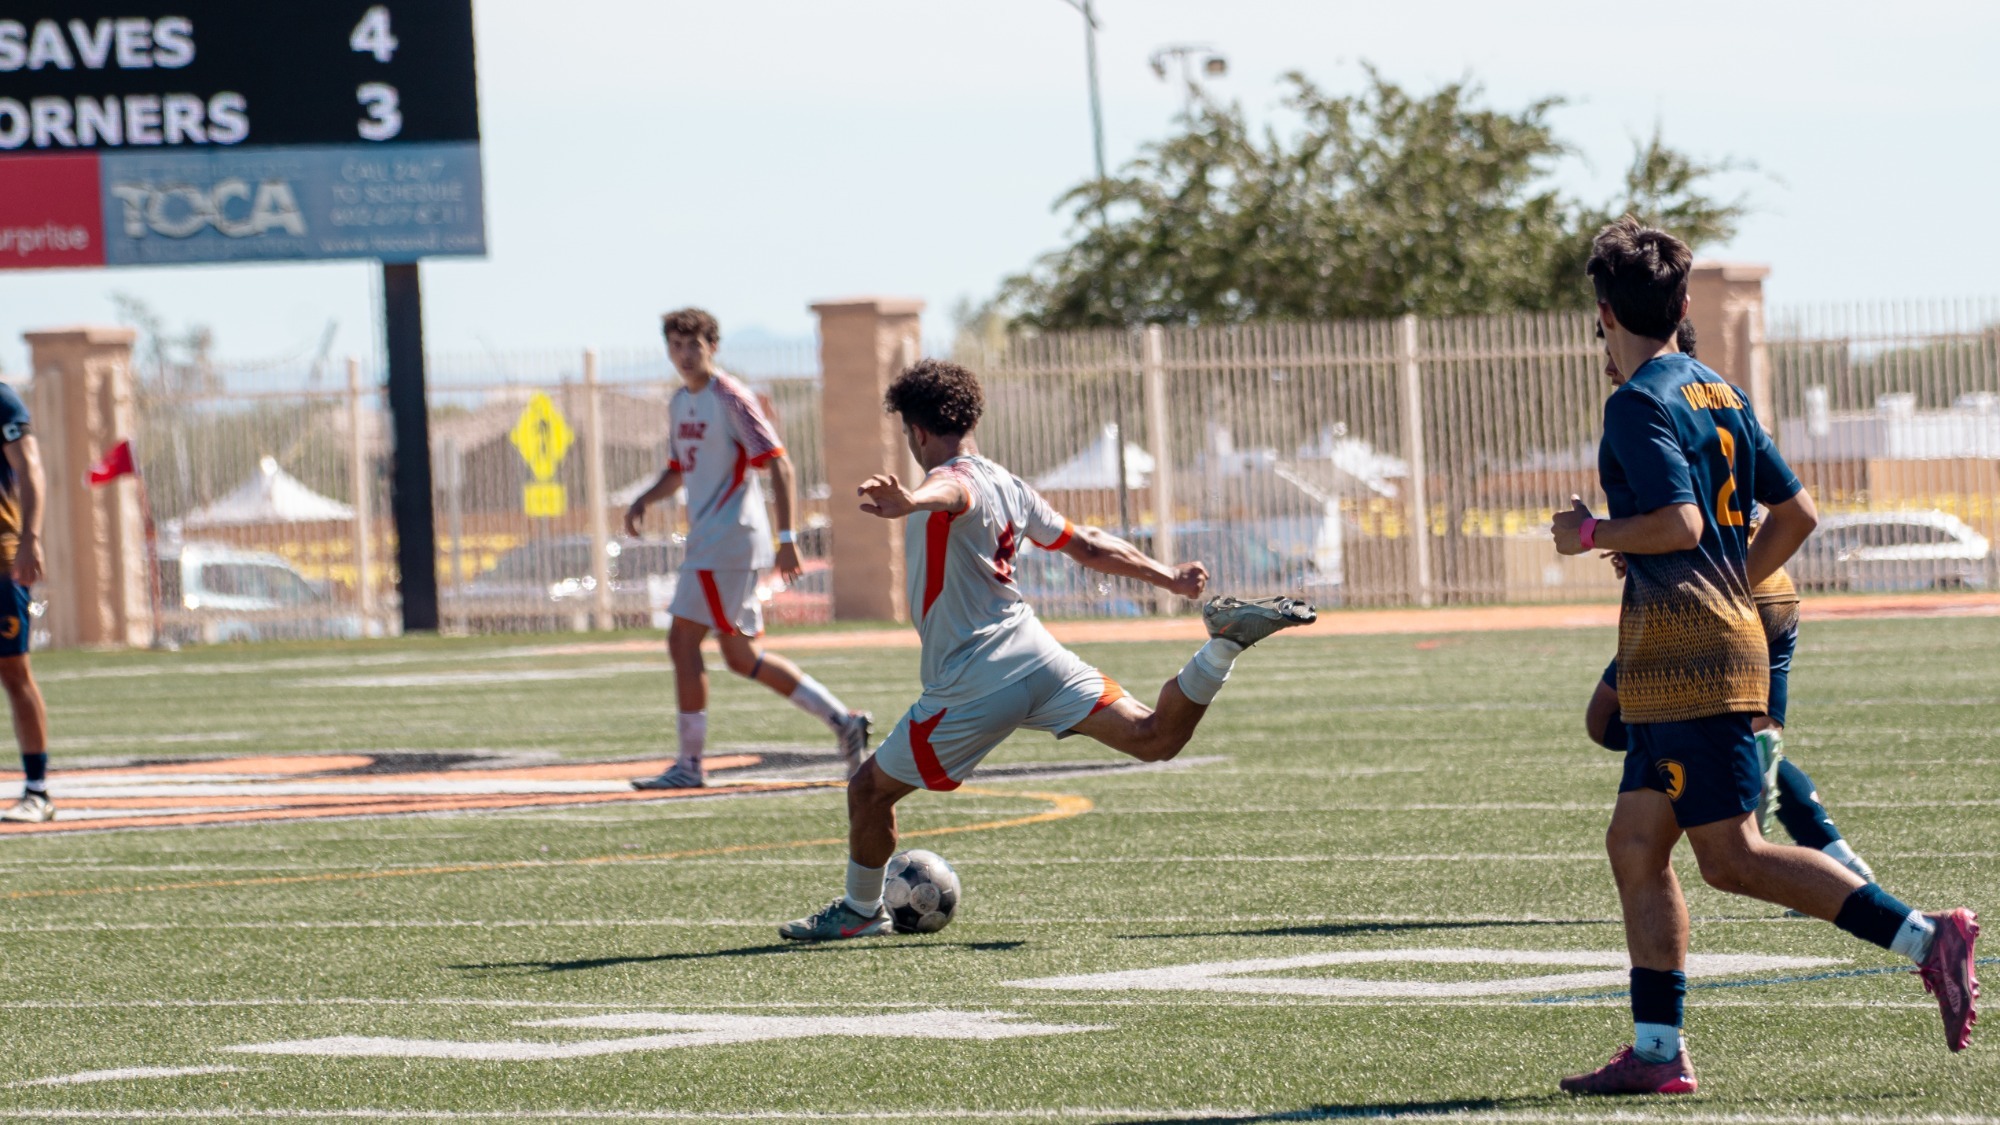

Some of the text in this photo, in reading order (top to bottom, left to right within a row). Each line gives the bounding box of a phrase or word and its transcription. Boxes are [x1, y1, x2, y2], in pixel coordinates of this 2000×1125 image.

[0, 5, 398, 71] SAVES 4
[0, 82, 402, 149] ORNERS 3
[0, 219, 89, 257] rprise
[111, 177, 308, 239] TOCA
[1716, 426, 1744, 526] 2
